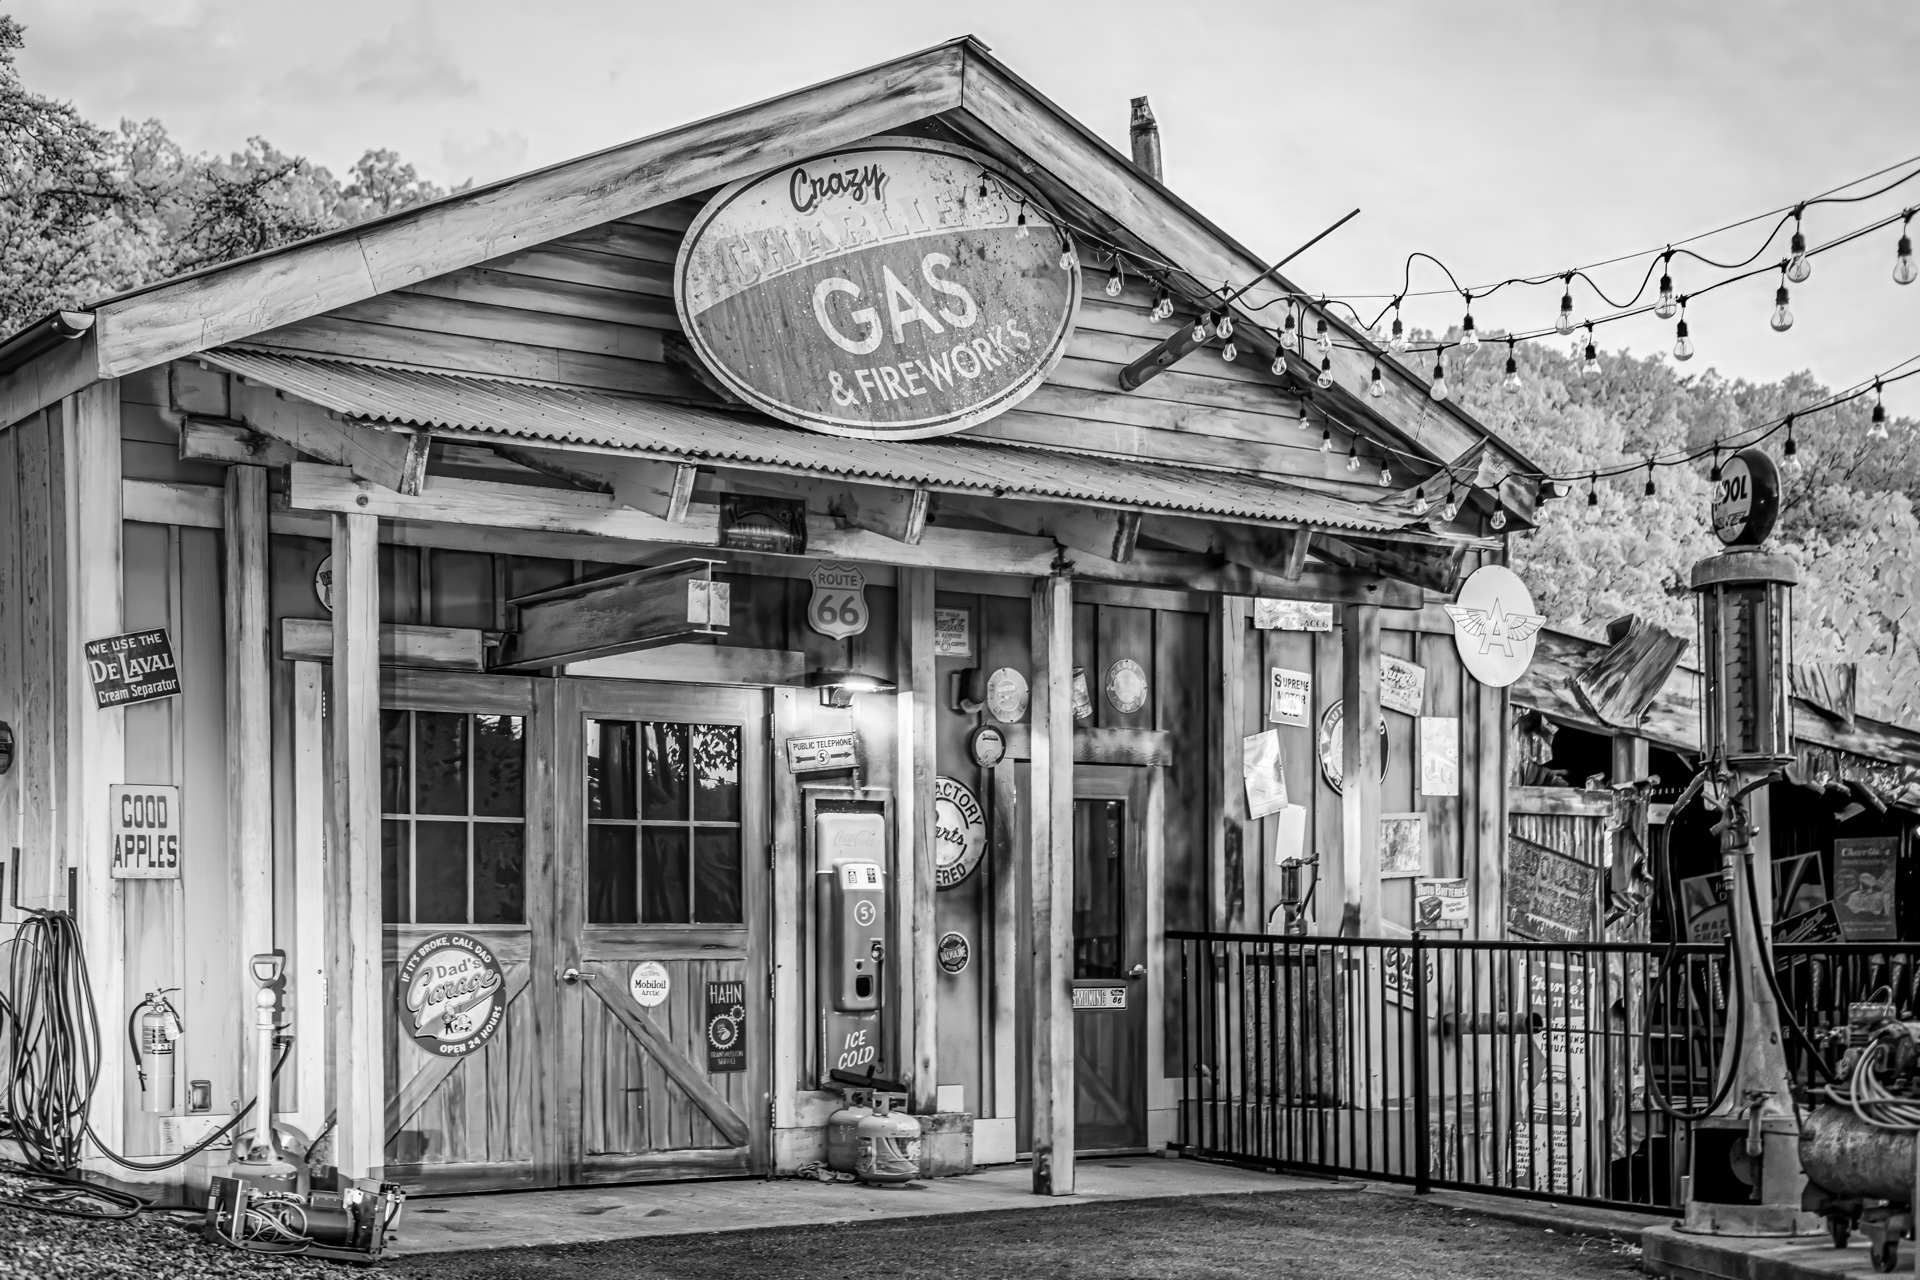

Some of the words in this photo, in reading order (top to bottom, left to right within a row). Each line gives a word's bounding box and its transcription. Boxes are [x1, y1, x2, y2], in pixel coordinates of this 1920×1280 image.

[789, 163, 888, 213] Crazy
[813, 252, 977, 355] GAS
[827, 370, 859, 406] &
[855, 318, 1031, 403] FIREWORKS
[818, 573, 858, 586] ROUTE
[817, 594, 860, 627] 66
[89, 643, 109, 655] WE
[111, 638, 137, 651] USE
[138, 633, 162, 646] THE
[99, 689, 130, 703] Cream
[130, 679, 177, 697] Separator
[1274, 674, 1309, 692] SUPREME
[793, 741, 815, 751] PUBLIC
[816, 738, 853, 749] TELEPHONE
[121, 793, 168, 829] GOOD
[936, 781, 983, 825] ACTORY
[936, 827, 965, 845] arts
[113, 833, 177, 868] APPLES
[1417, 883, 1435, 896] AUTO
[1435, 883, 1468, 897] BATTERIES
[401, 972, 411, 982] IF
[406, 954, 420, 971] IT'S
[418, 936, 450, 956] BROKE,
[452, 937, 474, 950] CALL
[475, 945, 491, 963] DAD
[436, 958, 482, 979] Dad's
[635, 980, 666, 989] Mobiloil
[709, 984, 742, 1004] HAHN
[406, 966, 498, 1029] Garage
[440, 1043, 466, 1054] OPEN
[468, 1036, 481, 1049] 24
[480, 1005, 502, 1038] HOURS
[844, 1029, 867, 1049] ICE
[838, 1045, 875, 1070] COLD
